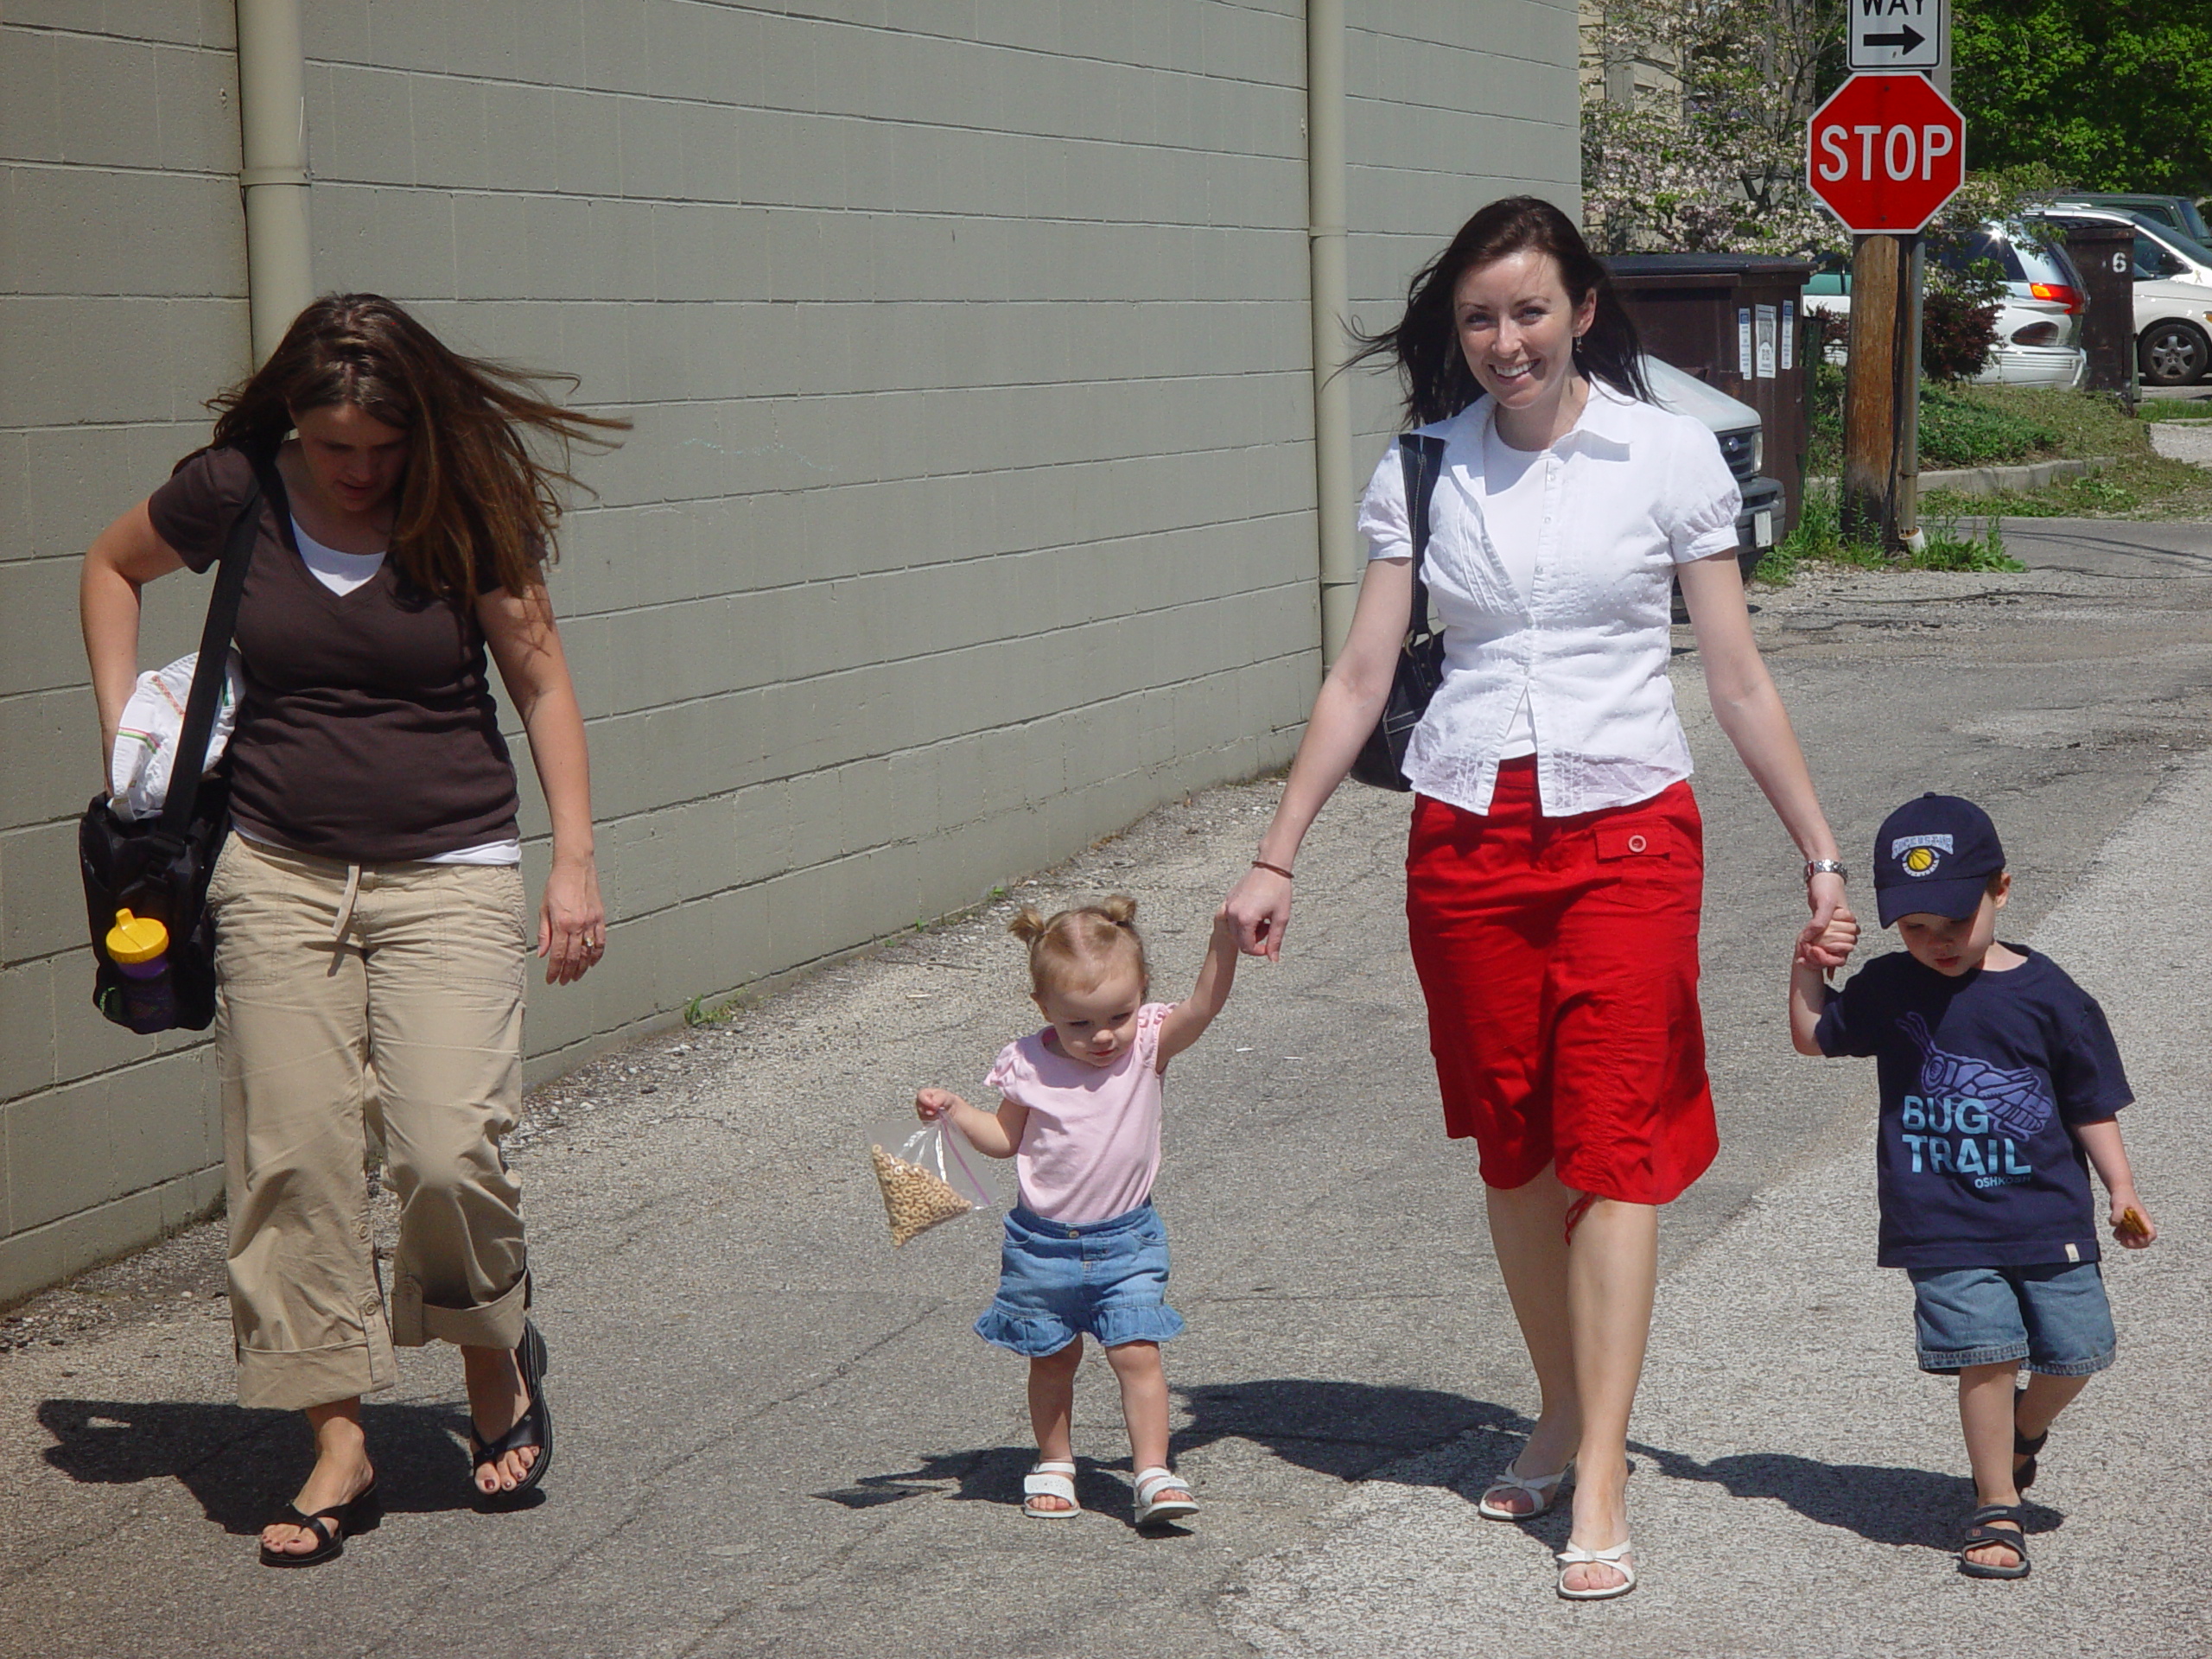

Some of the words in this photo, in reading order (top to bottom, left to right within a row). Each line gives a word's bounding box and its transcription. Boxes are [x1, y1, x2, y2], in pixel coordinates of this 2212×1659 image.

[1863, 0, 1923, 16] WAY
[1819, 124, 1954, 181] STOP
[2113, 251, 2126, 272] 6
[1902, 1095, 1989, 1135] BUG
[1902, 1134, 2031, 1176] TRAIL
[1974, 1176, 2031, 1189] OSHKOSH
